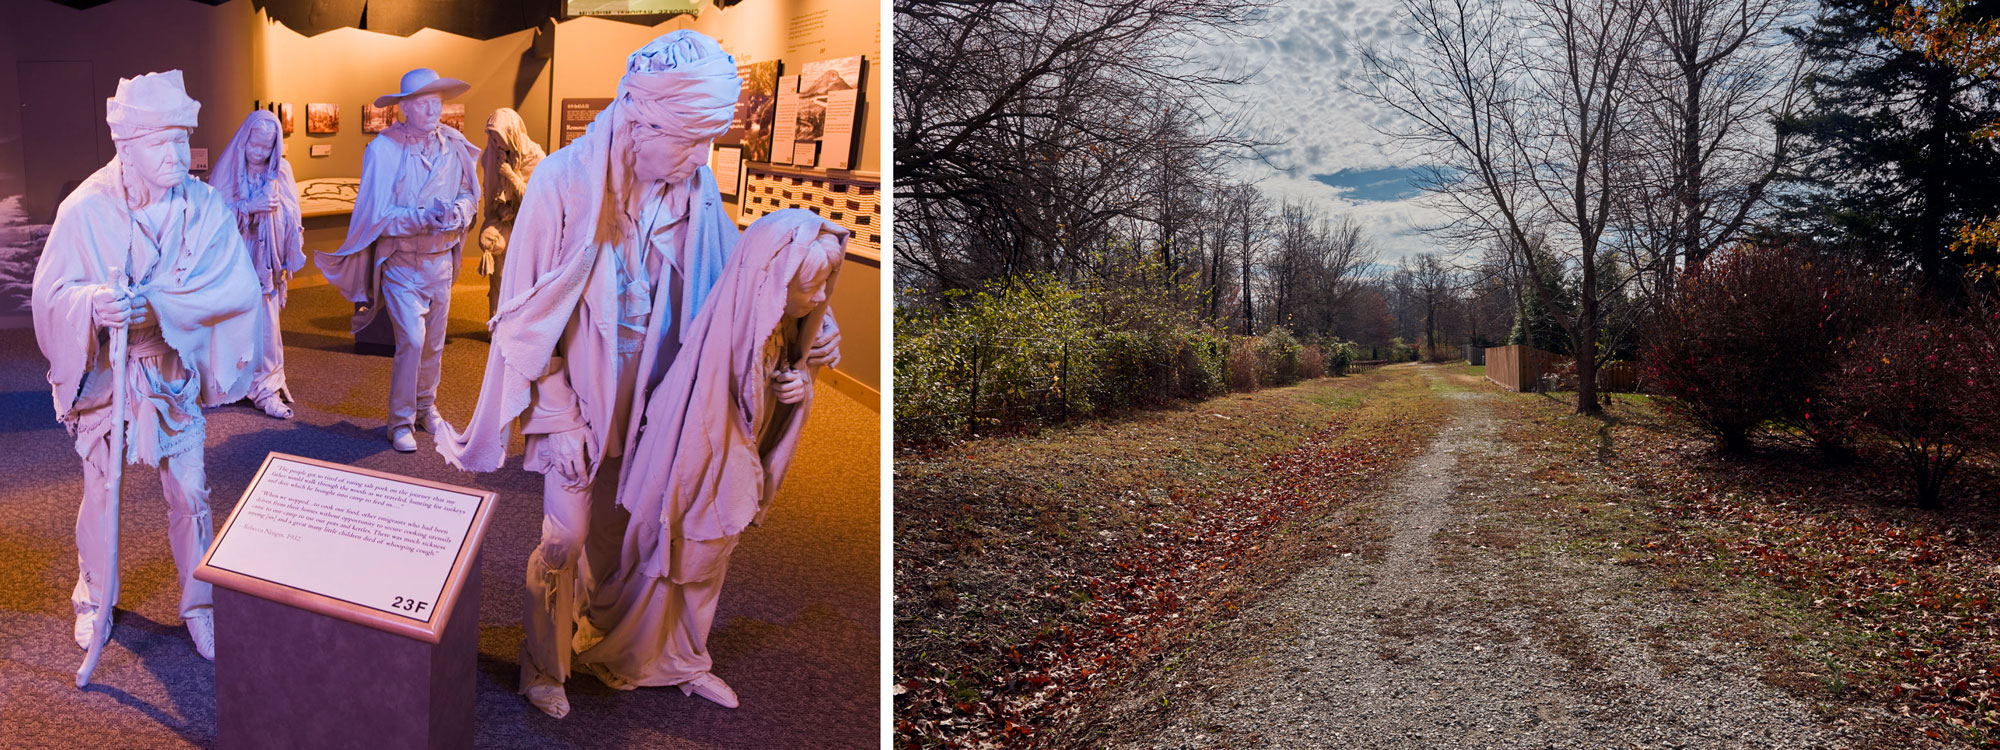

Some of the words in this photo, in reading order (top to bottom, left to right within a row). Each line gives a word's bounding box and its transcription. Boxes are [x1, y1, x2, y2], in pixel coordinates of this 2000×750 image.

[314, 486, 335, 495] brought
[317, 480, 338, 489] through
[409, 498, 432, 509] hunting
[443, 506, 465, 514] turkeys
[346, 479, 363, 487] eating
[408, 491, 430, 501] journey
[255, 496, 273, 504] driven
[300, 506, 318, 514] homes
[341, 516, 374, 527] opportunity
[403, 529, 427, 539] cooking
[377, 516, 406, 525] emigrants
[433, 526, 448, 534] been
[247, 510, 265, 519] among
[307, 523, 322, 532] many
[338, 530, 361, 539] children
[386, 541, 414, 552] whooping
[373, 529, 390, 538] There
[421, 541, 445, 549] sickness
[392, 596, 428, 612] 23F
